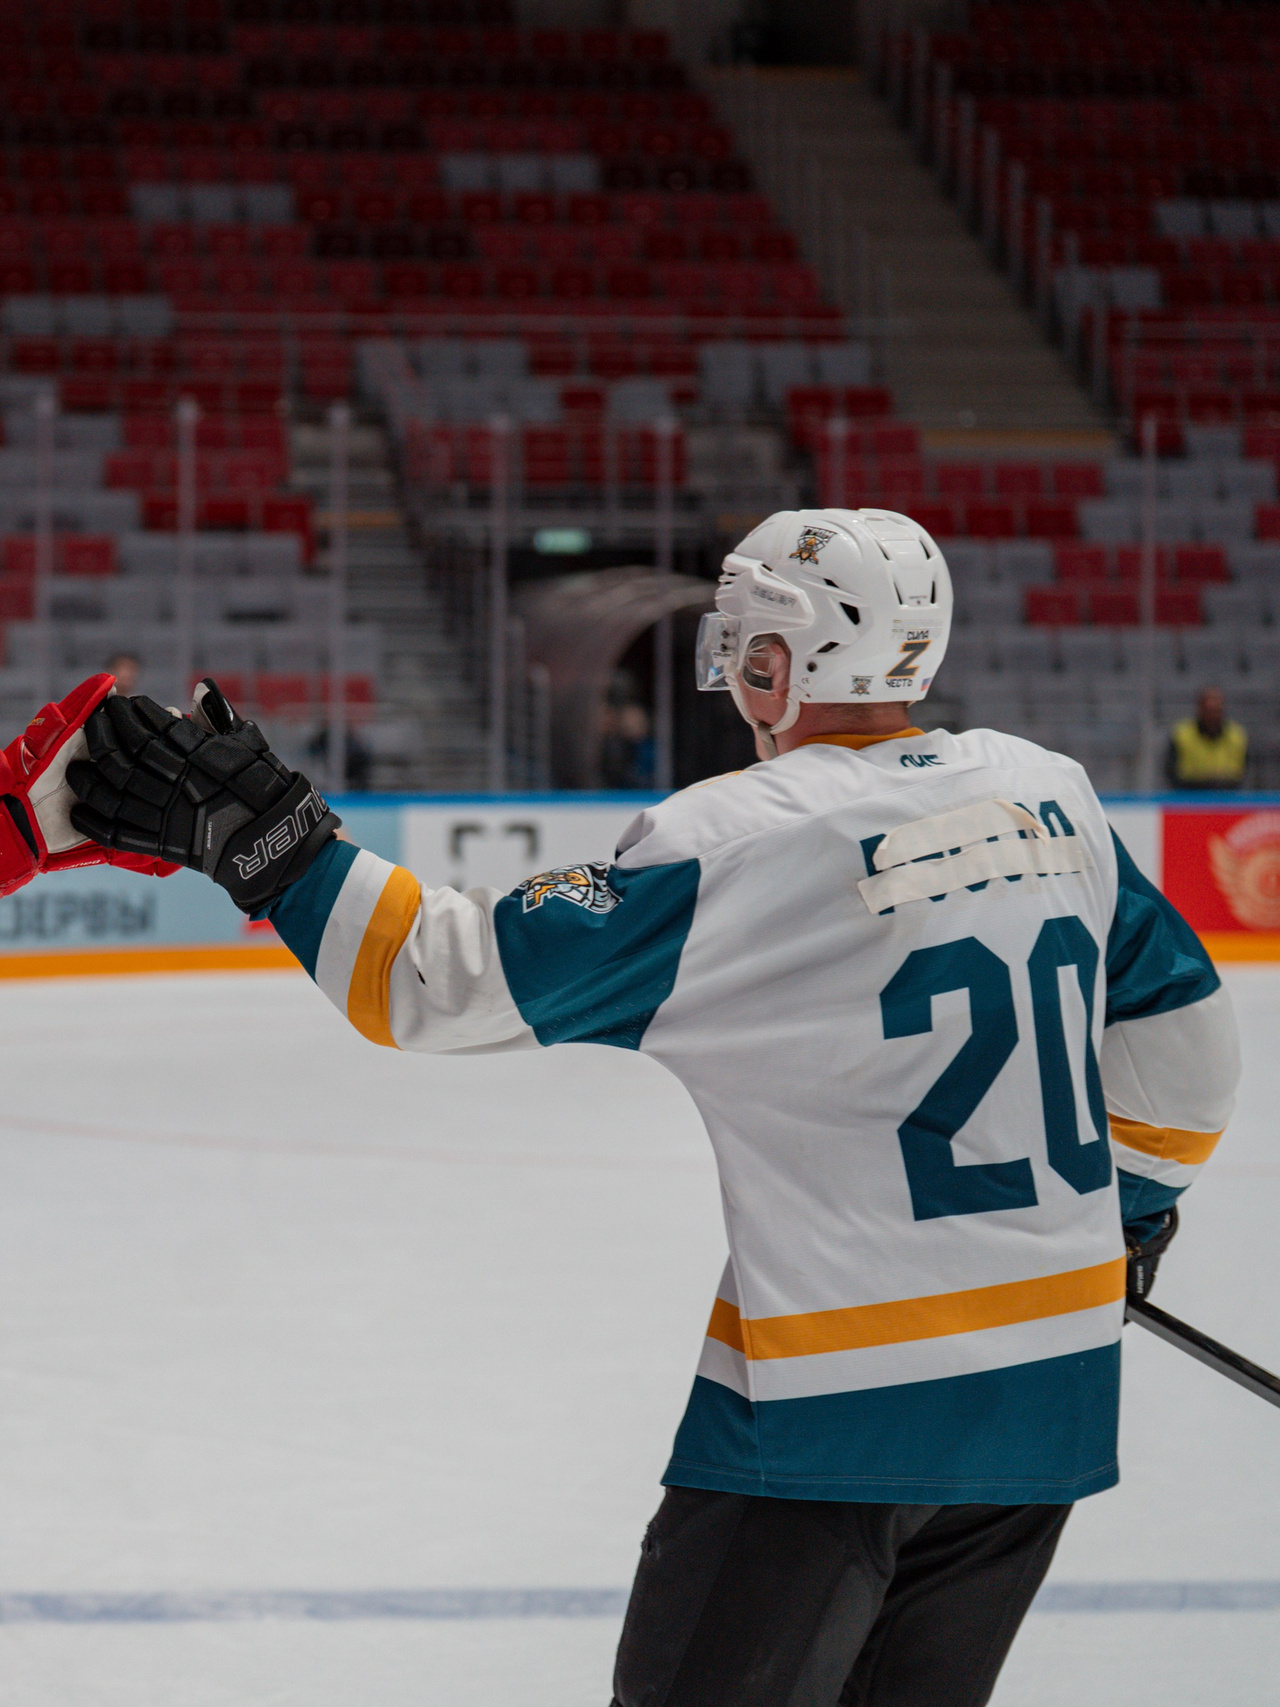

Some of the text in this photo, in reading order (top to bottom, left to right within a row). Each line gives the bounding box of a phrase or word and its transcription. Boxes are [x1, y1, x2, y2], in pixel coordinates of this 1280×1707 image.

[885, 640, 932, 679] Z
[232, 782, 328, 880] UER
[879, 915, 1112, 1222] 20
